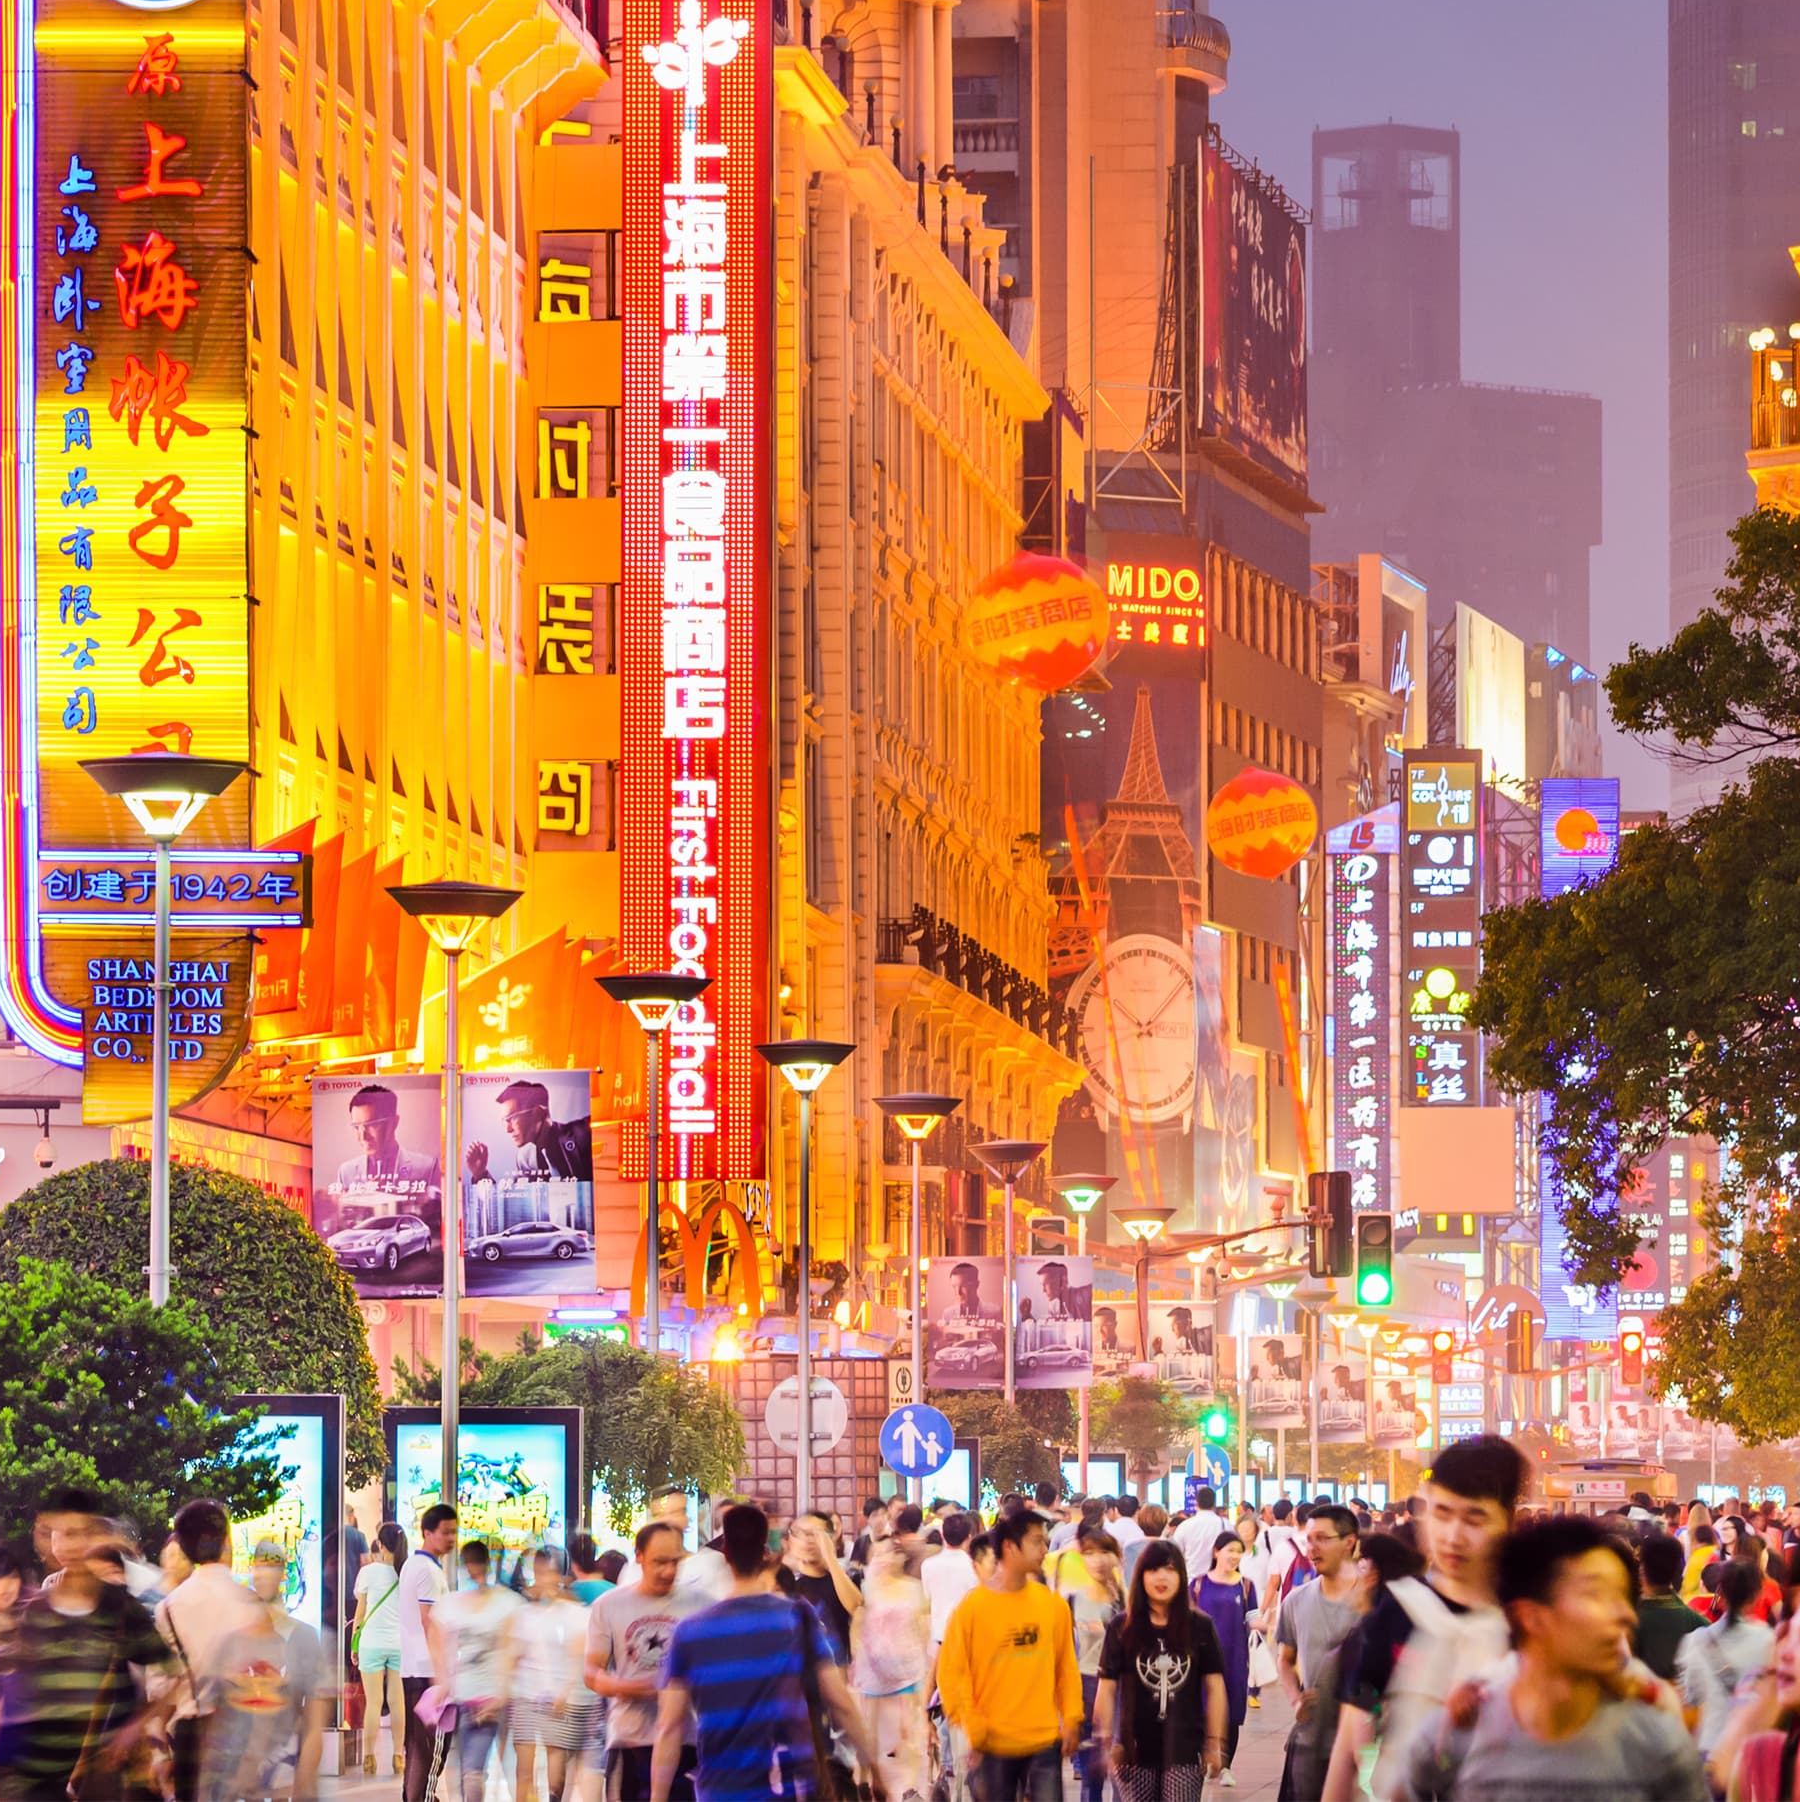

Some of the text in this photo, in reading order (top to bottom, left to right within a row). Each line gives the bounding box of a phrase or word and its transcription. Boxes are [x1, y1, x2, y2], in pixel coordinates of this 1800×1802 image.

[662, 131, 729, 739] 上海市第一食品商店
[670, 779, 718, 882] First
[331, 1081, 363, 1090] TOYOTA
[1428, 1041, 1467, 1103] 真丝
